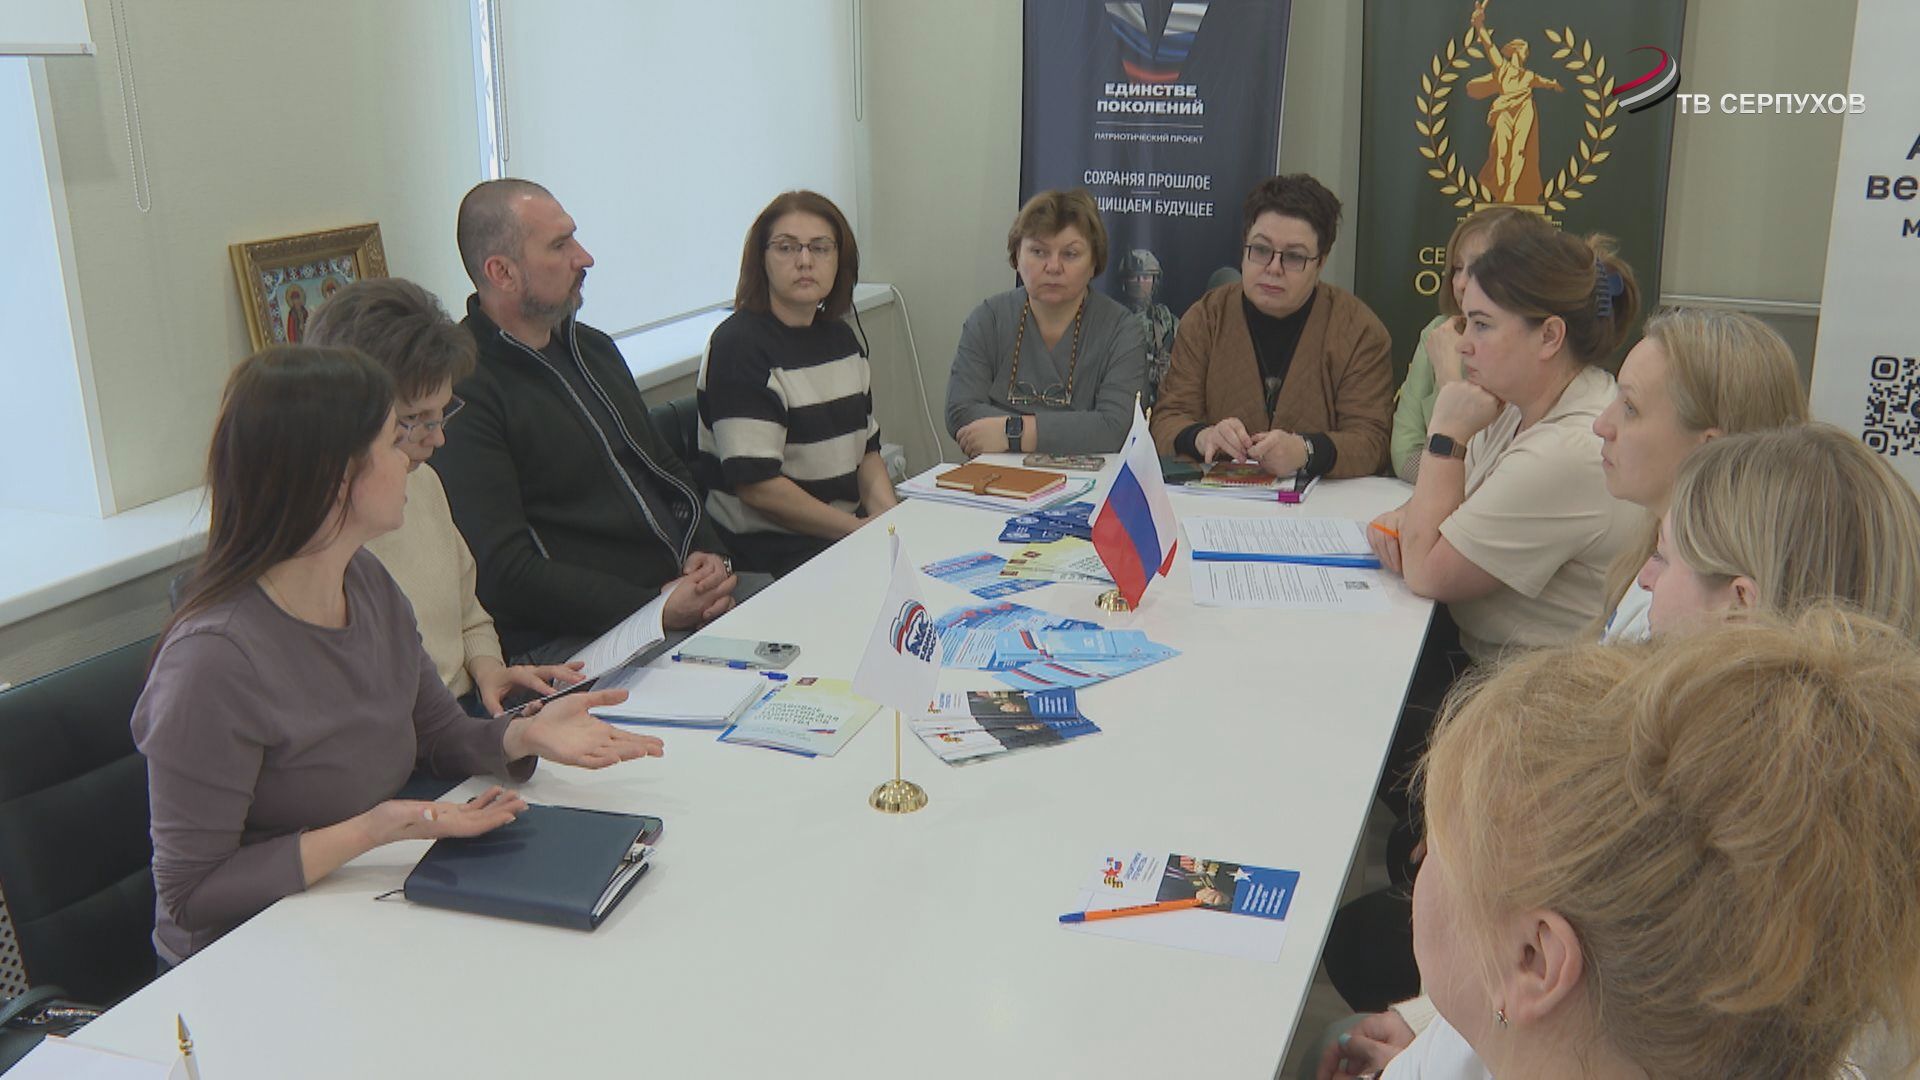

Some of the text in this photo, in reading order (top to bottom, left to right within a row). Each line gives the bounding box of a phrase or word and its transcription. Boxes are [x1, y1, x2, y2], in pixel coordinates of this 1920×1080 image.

[1105, 83, 1197, 98] ЕДИНСТВЕ
[1096, 99, 1204, 115] ПОКОЛЕНИЙ
[1094, 132, 1203, 144] ПАТРИОТИЧЕСКИЙ ПРОЕКТ
[1084, 169, 1211, 190] СОХРАНЯЯ ПРОШЛОЕ
[1094, 197, 1214, 218] ЩИЩАЕМ БУДУЩЕЕ
[1419, 246, 1446, 265] СЕ
